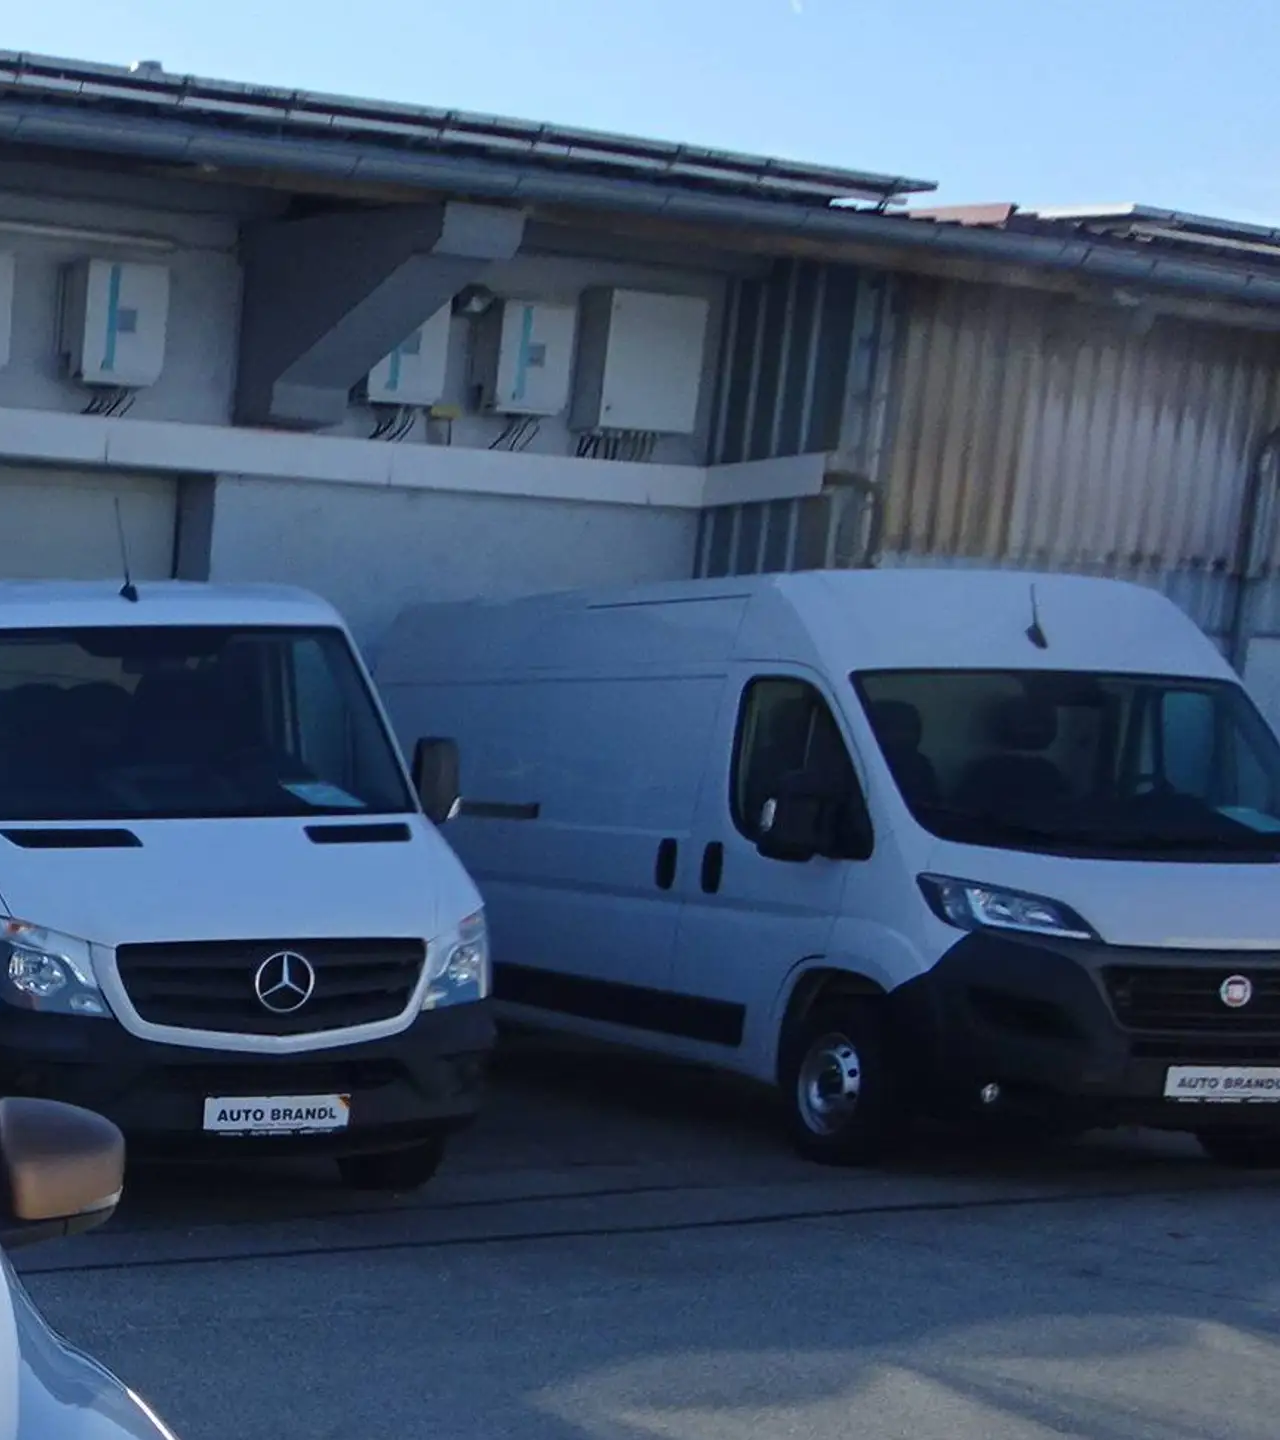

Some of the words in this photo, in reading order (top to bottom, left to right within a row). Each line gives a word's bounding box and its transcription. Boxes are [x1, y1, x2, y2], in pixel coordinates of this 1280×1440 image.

[1177, 1077, 1219, 1089] AUTO
[217, 1109, 265, 1122] AUTO
[270, 1107, 338, 1121] BRANDL
